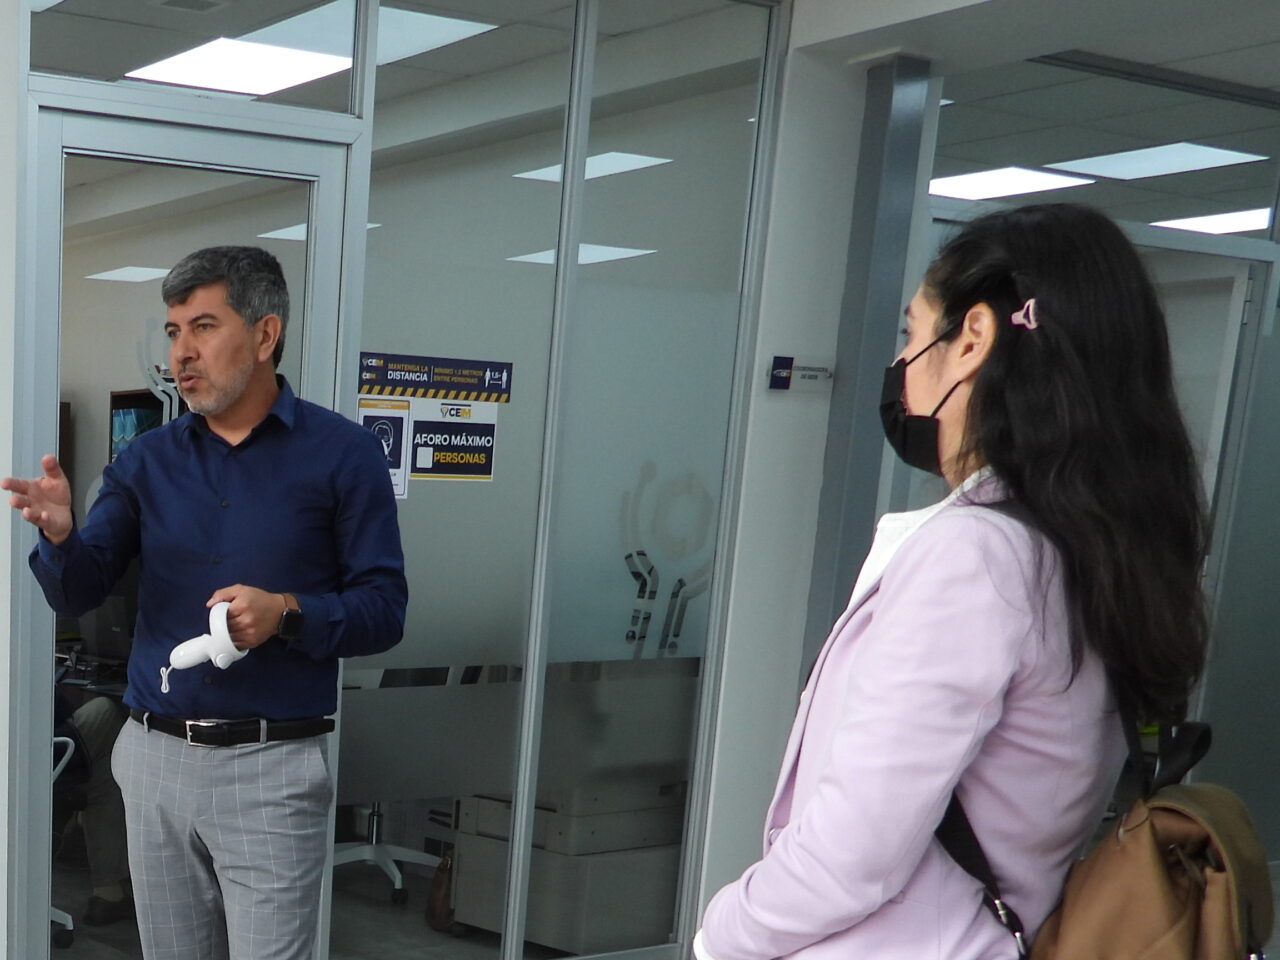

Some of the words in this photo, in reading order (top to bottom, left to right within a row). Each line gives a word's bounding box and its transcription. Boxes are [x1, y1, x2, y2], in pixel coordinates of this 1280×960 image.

[388, 363, 419, 371] MANTENGA
[387, 370, 428, 382] DISTANCIA
[449, 408, 472, 418] CEIM
[414, 433, 449, 446] AFORO
[451, 432, 493, 447] MÁXIMO
[434, 451, 486, 464] PERSONAS
